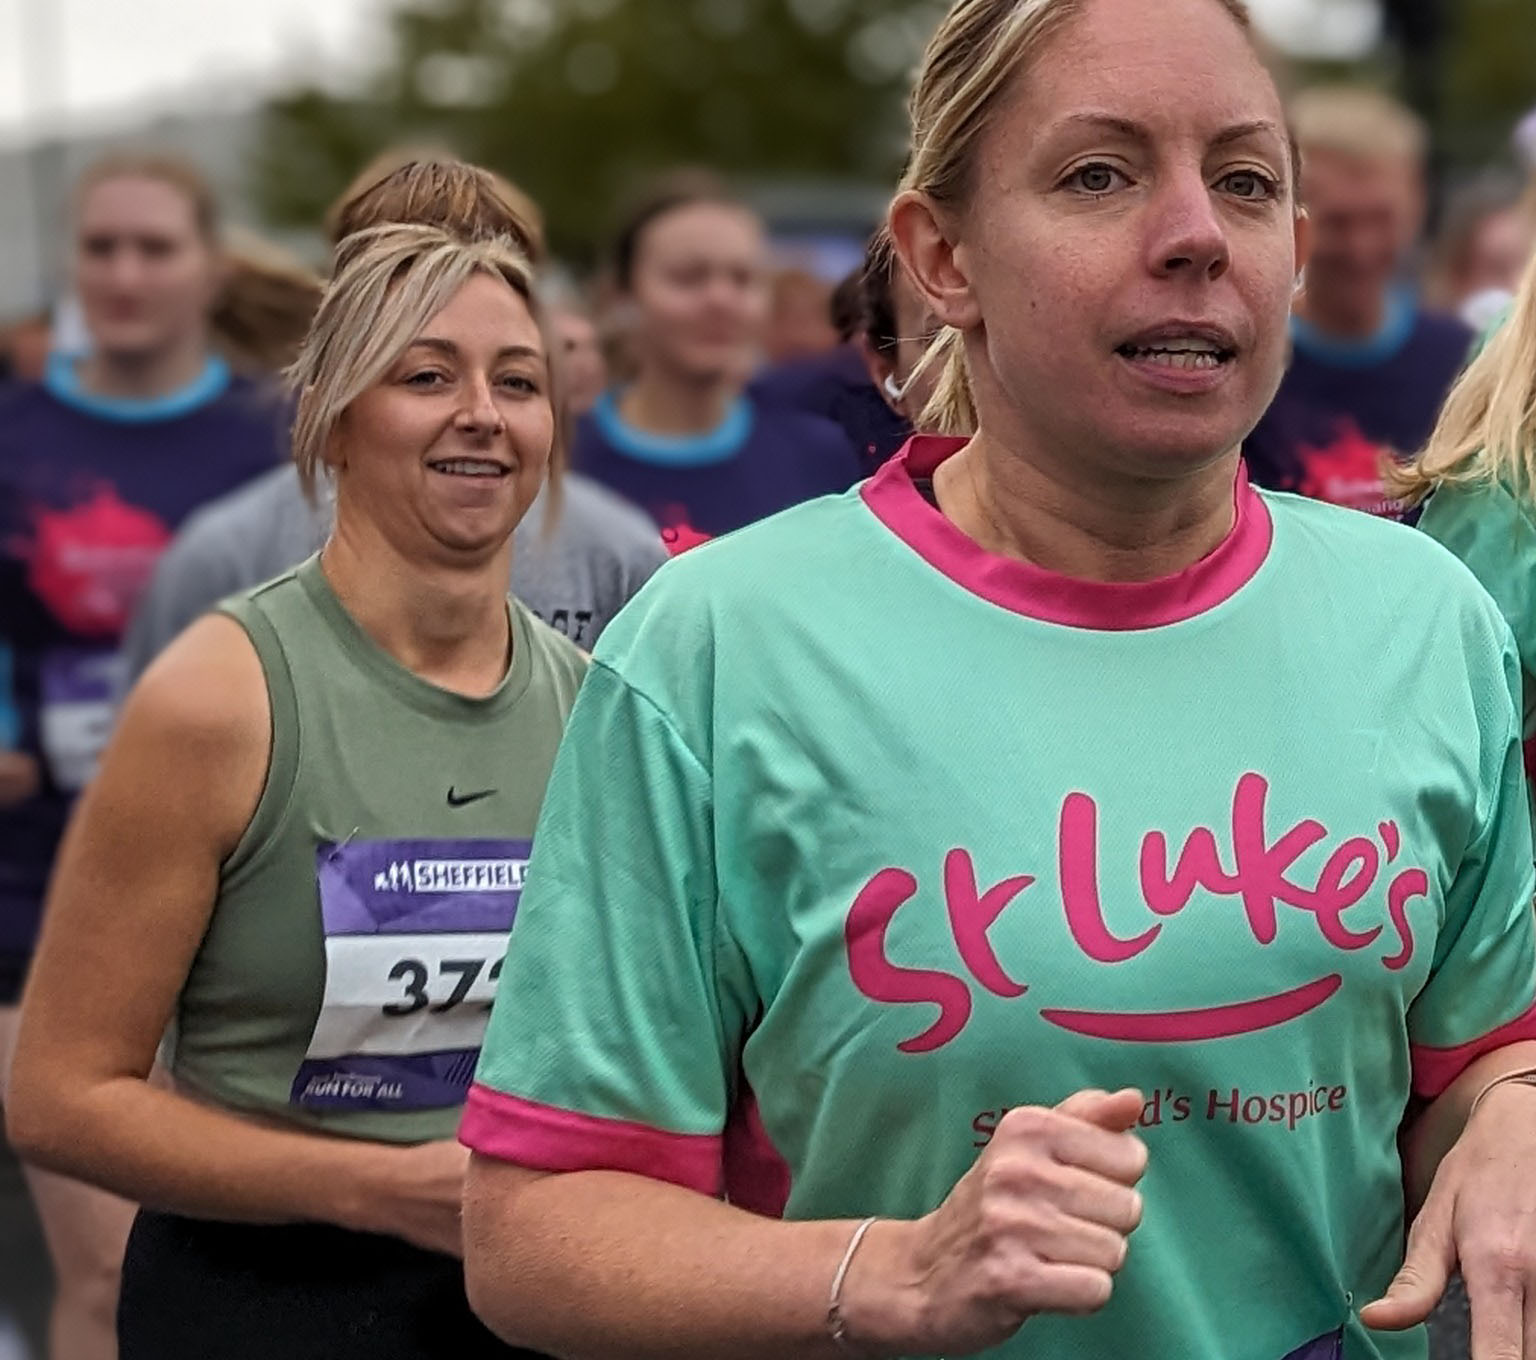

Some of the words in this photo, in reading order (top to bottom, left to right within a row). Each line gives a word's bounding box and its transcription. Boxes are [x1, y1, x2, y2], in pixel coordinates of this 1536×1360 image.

[844, 847, 1035, 1054] St
[1059, 772, 1429, 970] Luke's
[1207, 1080, 1347, 1130] Hospice
